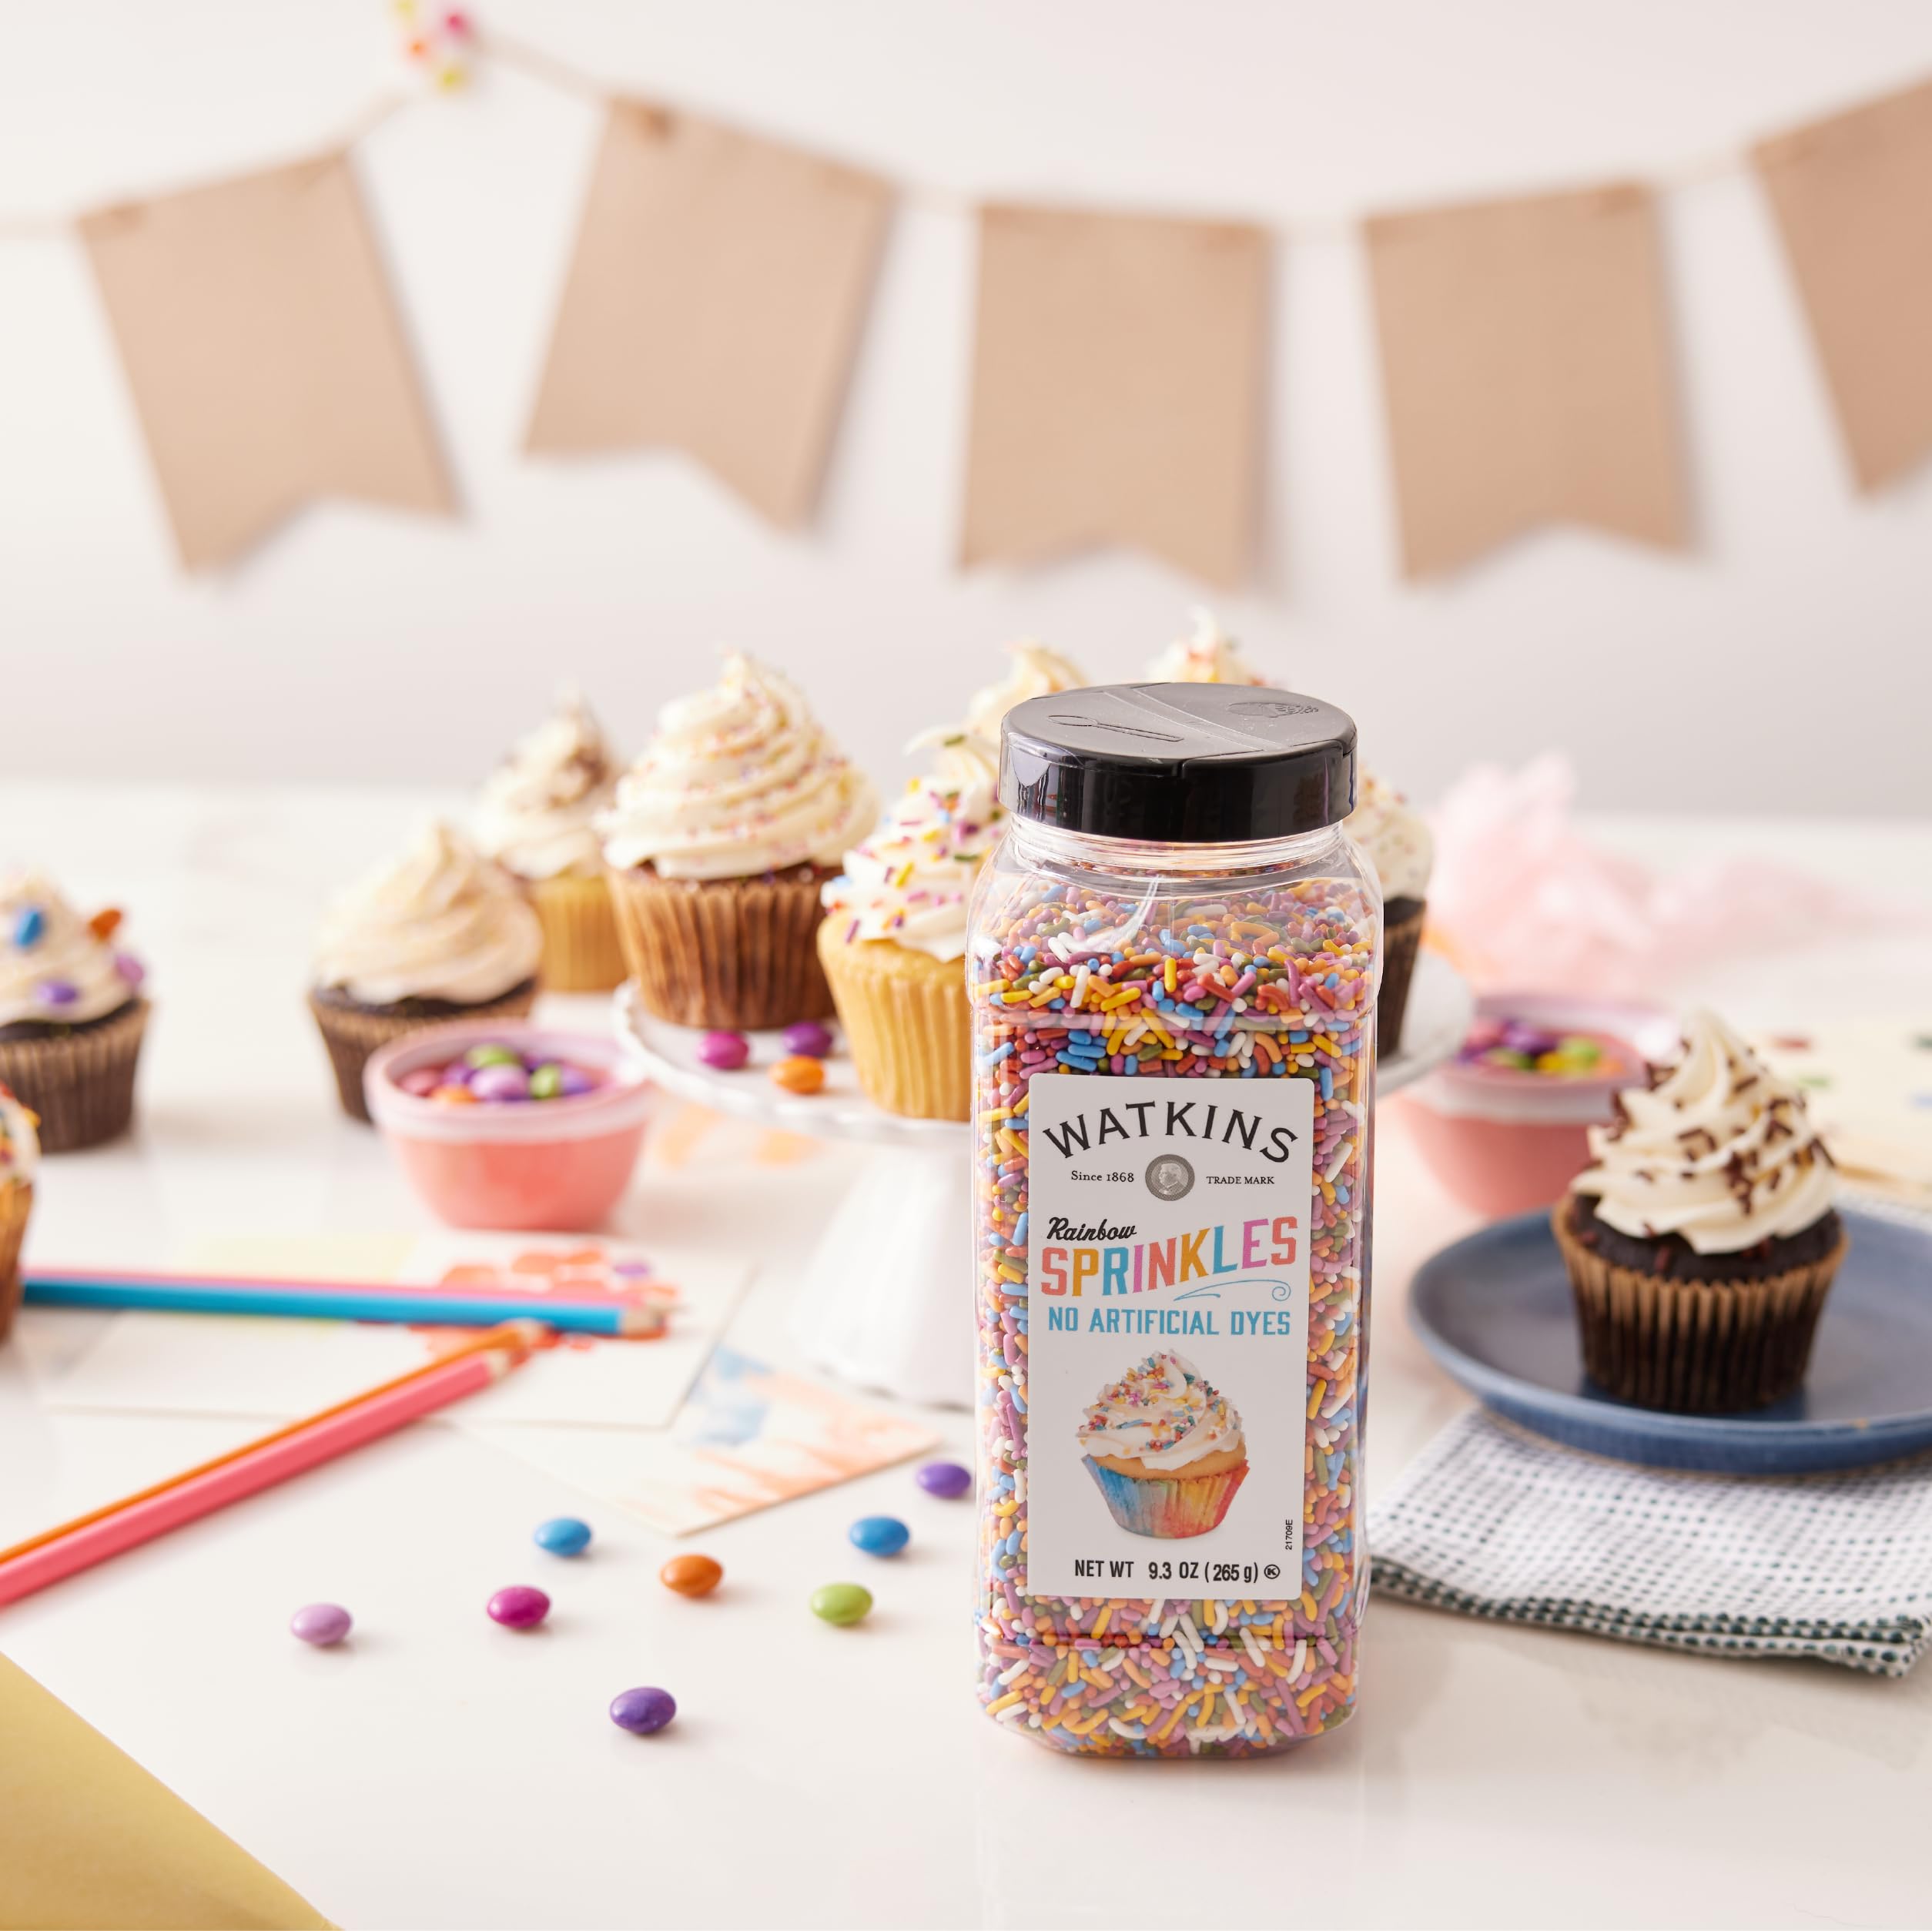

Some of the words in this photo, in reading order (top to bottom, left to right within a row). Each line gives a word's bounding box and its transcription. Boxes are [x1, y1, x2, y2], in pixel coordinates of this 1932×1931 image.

[1042, 1100, 1298, 1163] WATKINS
[1070, 1170, 1103, 1182] Since
[1106, 1171, 1135, 1183] 1868
[1205, 1176, 1242, 1185] TRADE
[1244, 1176, 1275, 1185] MARK
[1046, 1216, 1137, 1241] Rainbow
[1041, 1216, 1298, 1297] SPRINKLES
[1048, 1307, 1079, 1332] NO
[1089, 1308, 1220, 1335] ARTIFICIAL
[1231, 1310, 1291, 1336] DYES
[1284, 1518, 1294, 1551] 21709E
[1074, 1559, 1105, 1578] NET
[1110, 1560, 1135, 1578] WT
[1147, 1561, 1173, 1580] 9.3
[1178, 1561, 1200, 1579] OZ
[1204, 1561, 1240, 1583] (265
